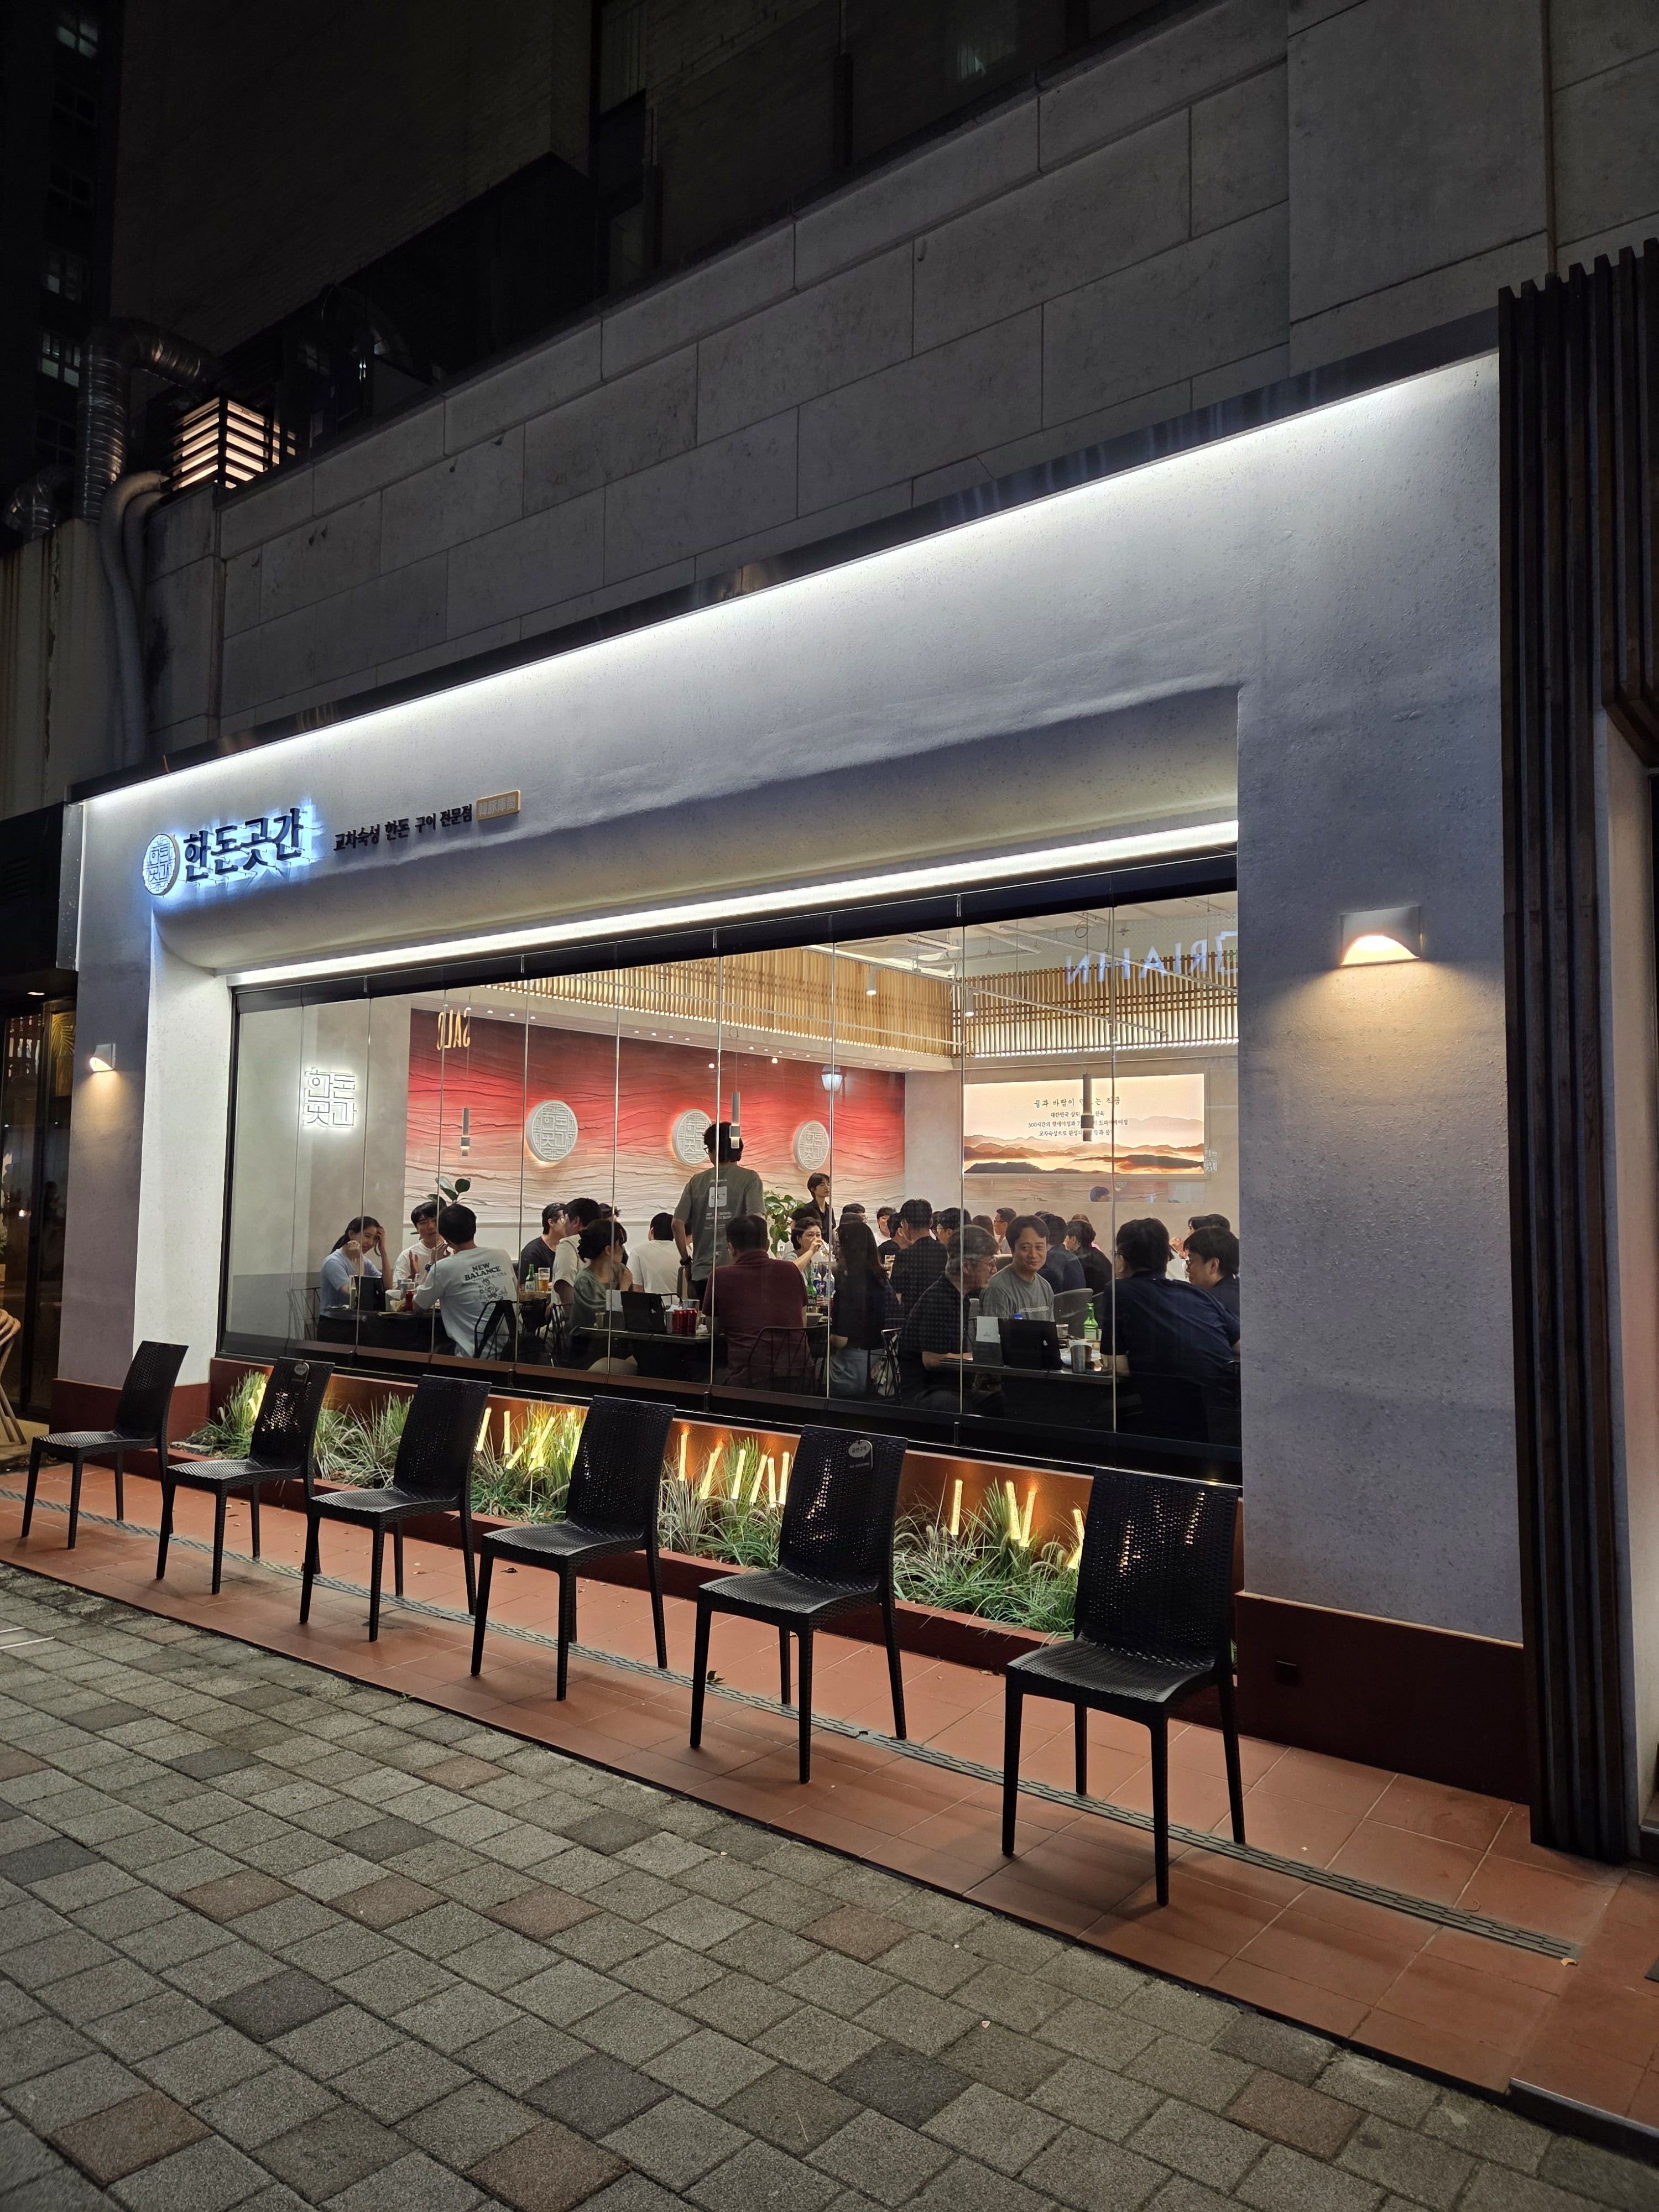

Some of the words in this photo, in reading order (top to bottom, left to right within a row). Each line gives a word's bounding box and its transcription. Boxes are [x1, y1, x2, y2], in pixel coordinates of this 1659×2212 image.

[333, 824, 380, 851] 교차숙성
[385, 818, 410, 841] 한돈
[415, 813, 436, 833] 구이
[440, 804, 472, 827] 전문점
[184, 807, 304, 882] 한돈곳간
[1053, 1098, 1074, 1107] 바람이
[464, 1266, 501, 1281] BALANCE
[472, 1262, 490, 1272] NEW
